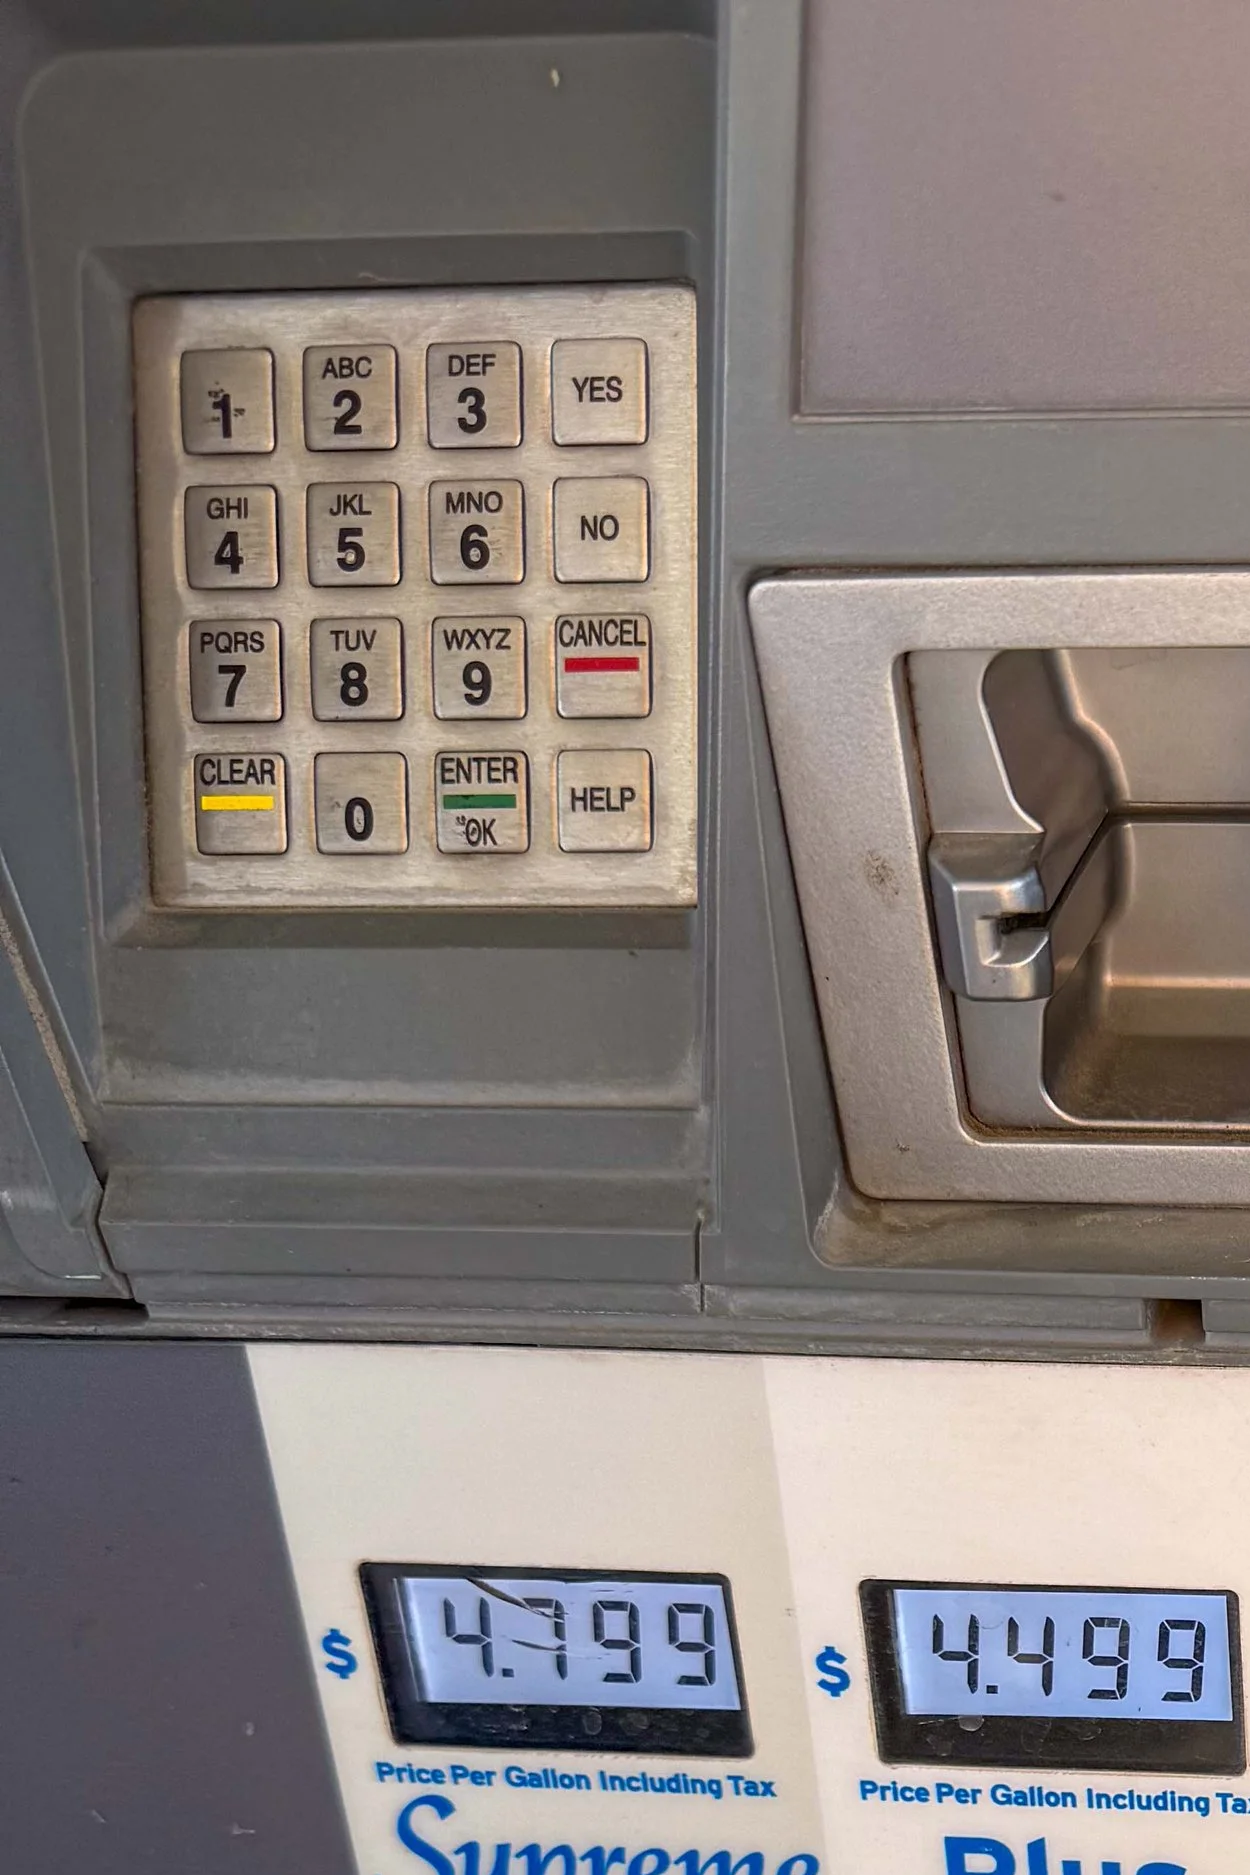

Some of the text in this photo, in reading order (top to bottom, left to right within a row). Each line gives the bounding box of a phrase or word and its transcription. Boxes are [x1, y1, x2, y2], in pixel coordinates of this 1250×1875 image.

[321, 355, 373, 380] ABC
[447, 353, 497, 377] DEF
[571, 375, 623, 403] YES
[212, 395, 234, 439] 1
[333, 389, 363, 436] 2
[457, 386, 487, 435] 3
[205, 496, 249, 520] GHI
[328, 493, 372, 517] JKL
[445, 490, 504, 515] MNO
[580, 514, 620, 542] NO
[213, 530, 244, 575] 4
[336, 527, 366, 573] 5
[459, 523, 490, 571] 6
[199, 630, 265, 655] PQRS
[329, 629, 377, 652] TUV
[442, 627, 512, 651] WXYZ
[556, 618, 647, 648] CANCEL
[217, 664, 247, 708] 7
[339, 661, 369, 707] 8
[462, 660, 492, 706] 9
[197, 756, 276, 788] CLEAR
[440, 756, 519, 785] ENTER
[570, 786, 636, 813] HELP
[344, 796, 374, 842] 0
[465, 816, 497, 847] OK
[321, 1596, 717, 1687] $ 4.799
[815, 1613, 1207, 1704] $ 4.499
[375, 1761, 777, 1800] Price Per Gallon Including Tax
[859, 1779, 930, 1803] Price
[935, 1782, 982, 1805] Per
[990, 1783, 1077, 1808] Gallon
[1086, 1787, 1210, 1818] Including
